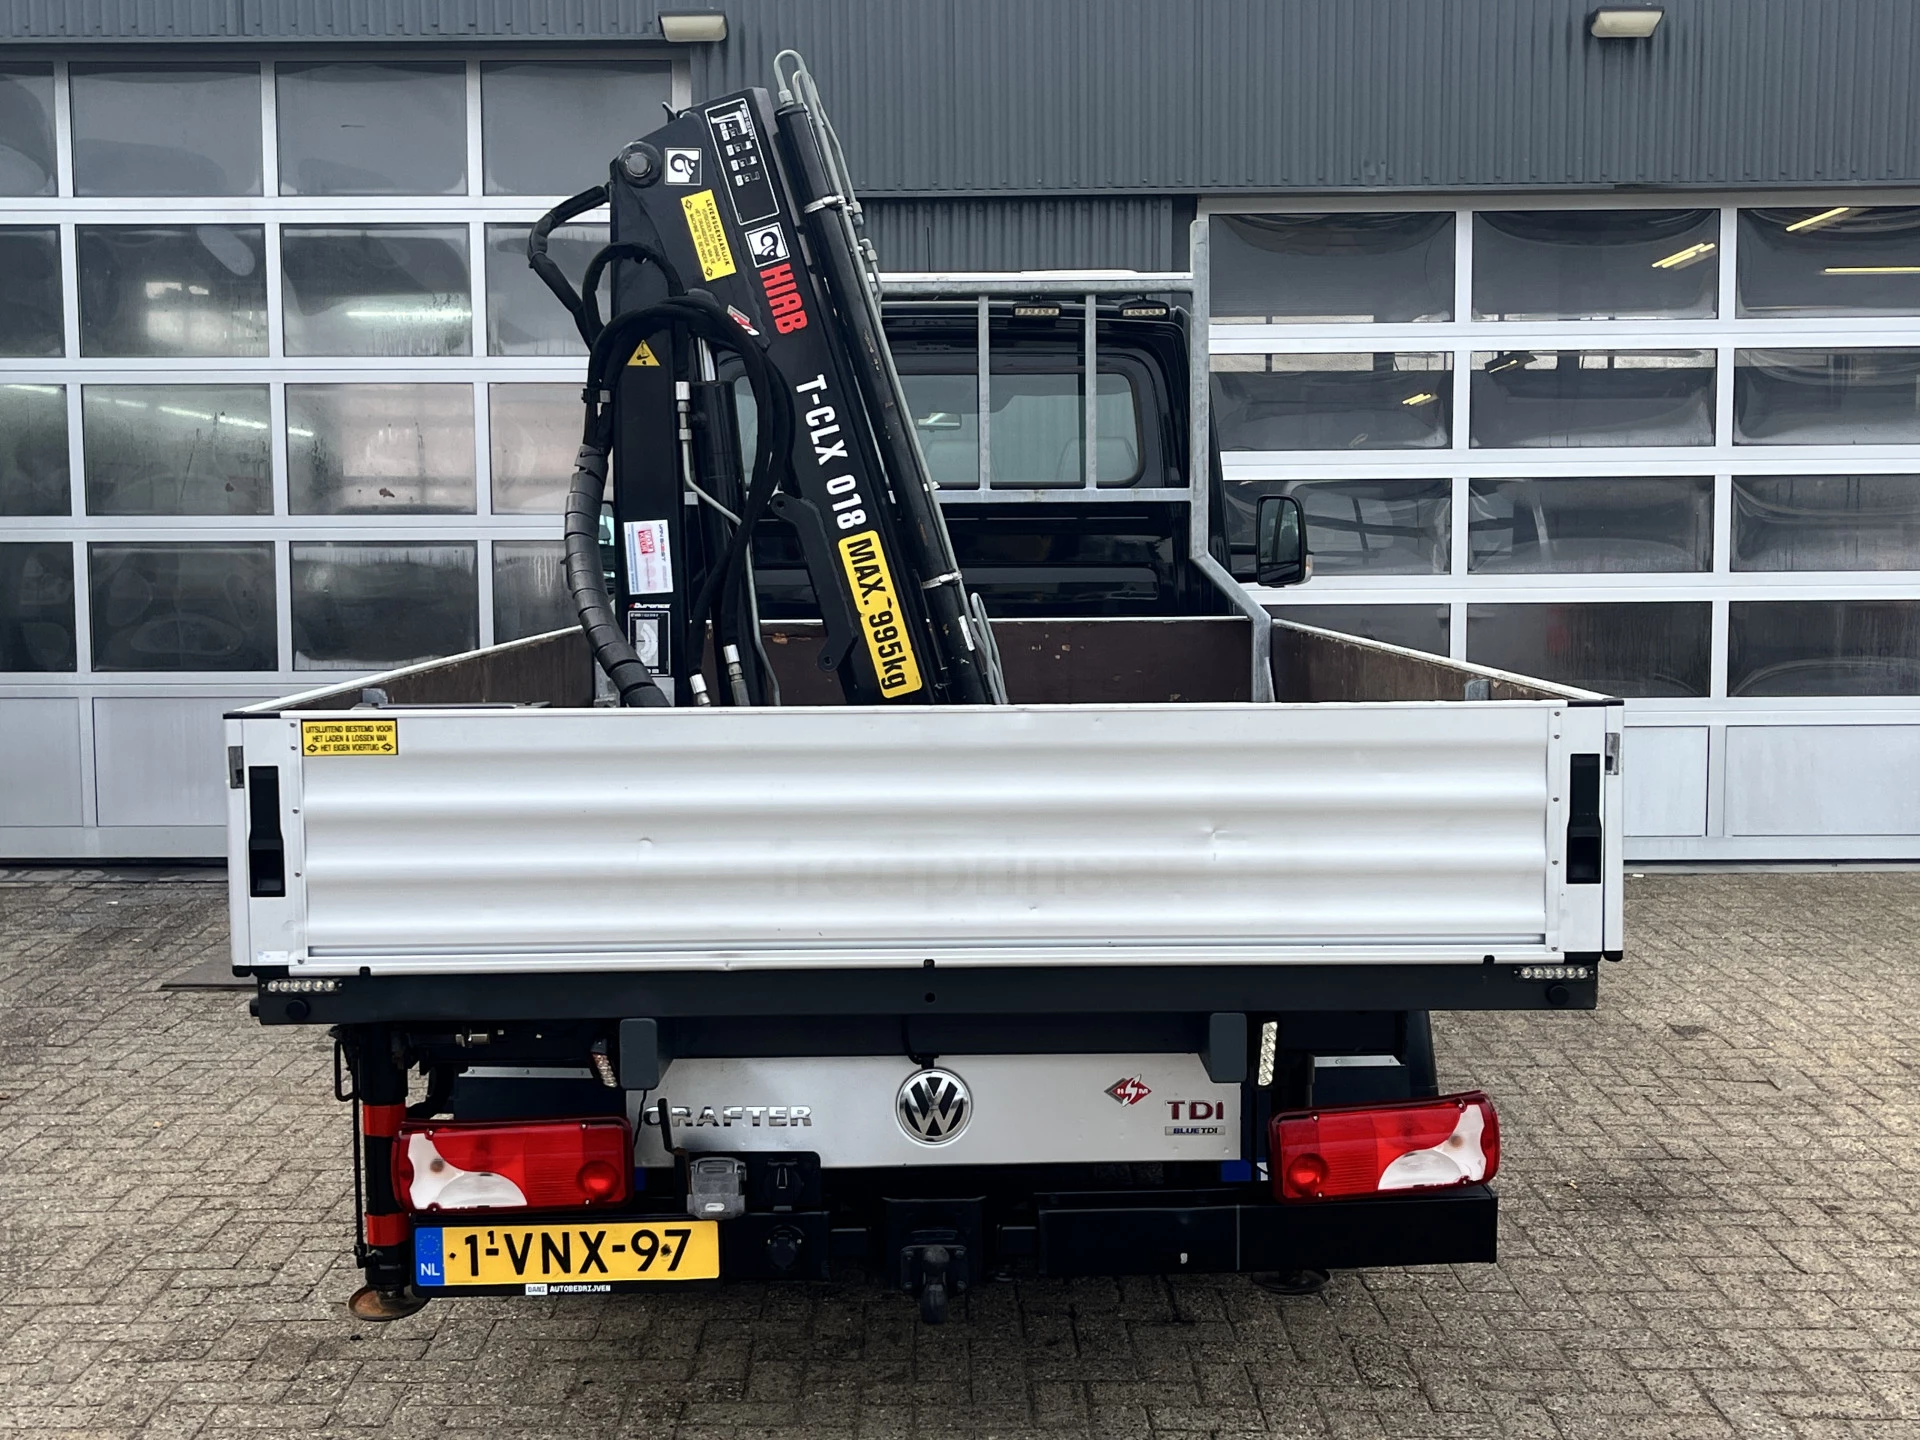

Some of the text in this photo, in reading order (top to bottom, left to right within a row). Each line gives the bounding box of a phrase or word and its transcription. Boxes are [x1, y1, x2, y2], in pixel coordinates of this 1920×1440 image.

[706, 199, 730, 266] LEVENSGEVAARLIJK
[760, 263, 808, 334] HIAB
[796, 375, 867, 530] T-CLX 018
[847, 538, 908, 691] MAX. 995kg
[1166, 1101, 1224, 1120] TDI
[420, 1264, 440, 1276] NL
